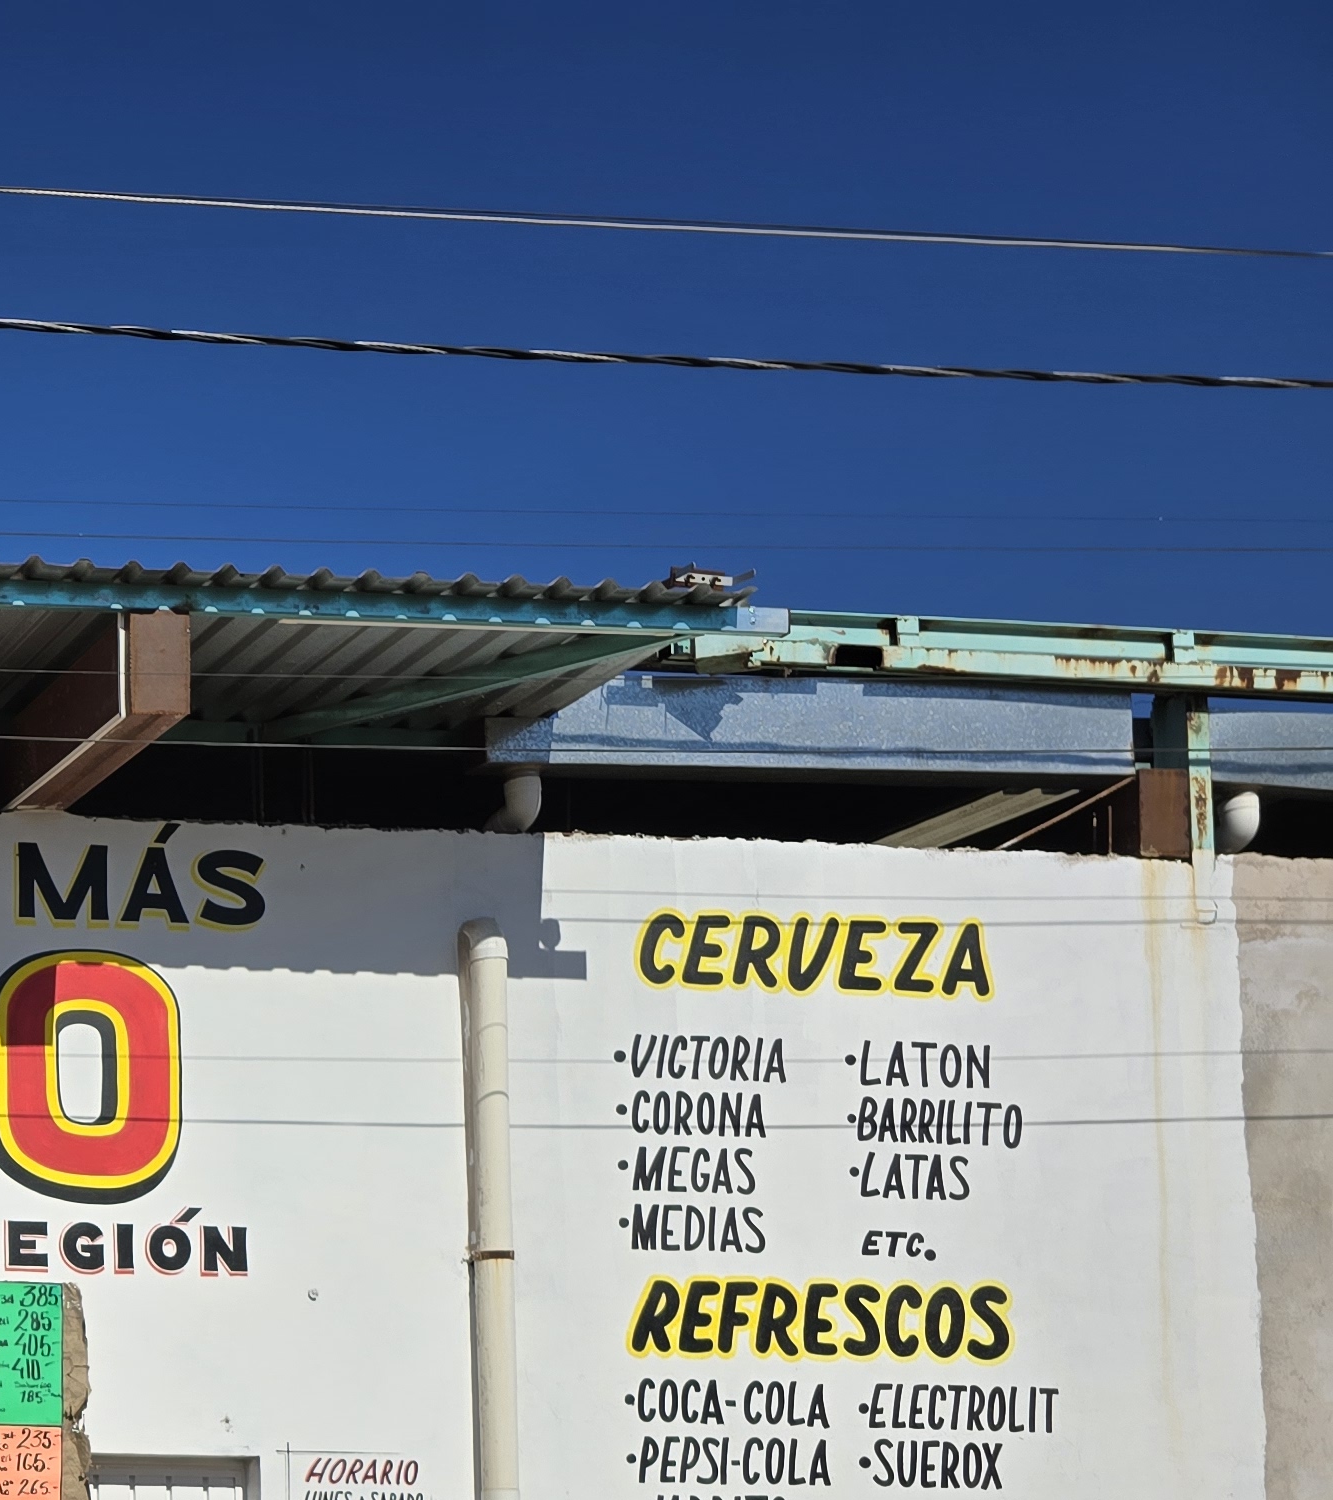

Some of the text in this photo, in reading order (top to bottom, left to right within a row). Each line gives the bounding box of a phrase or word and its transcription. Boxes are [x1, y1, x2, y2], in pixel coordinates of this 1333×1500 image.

[14, 824, 267, 932] MÁS
[636, 912, 992, 999] CERVEZA
[631, 1034, 786, 1083] VICTORIA
[860, 1040, 990, 1088] LATON
[632, 1090, 766, 1138] CORONA
[857, 1096, 1023, 1149] BARRILITO
[633, 1146, 756, 1195] MEGAS
[860, 1151, 970, 1201] LATAS
[631, 1204, 766, 1253] MEDIAS
[861, 1230, 937, 1261] ETC.
[630, 1278, 1012, 1361] REFRESCOS
[868, 1383, 1059, 1433] ELECTROLIT
[304, 1457, 419, 1485] HORARIO
[872, 1440, 1003, 1490] SUEROX
